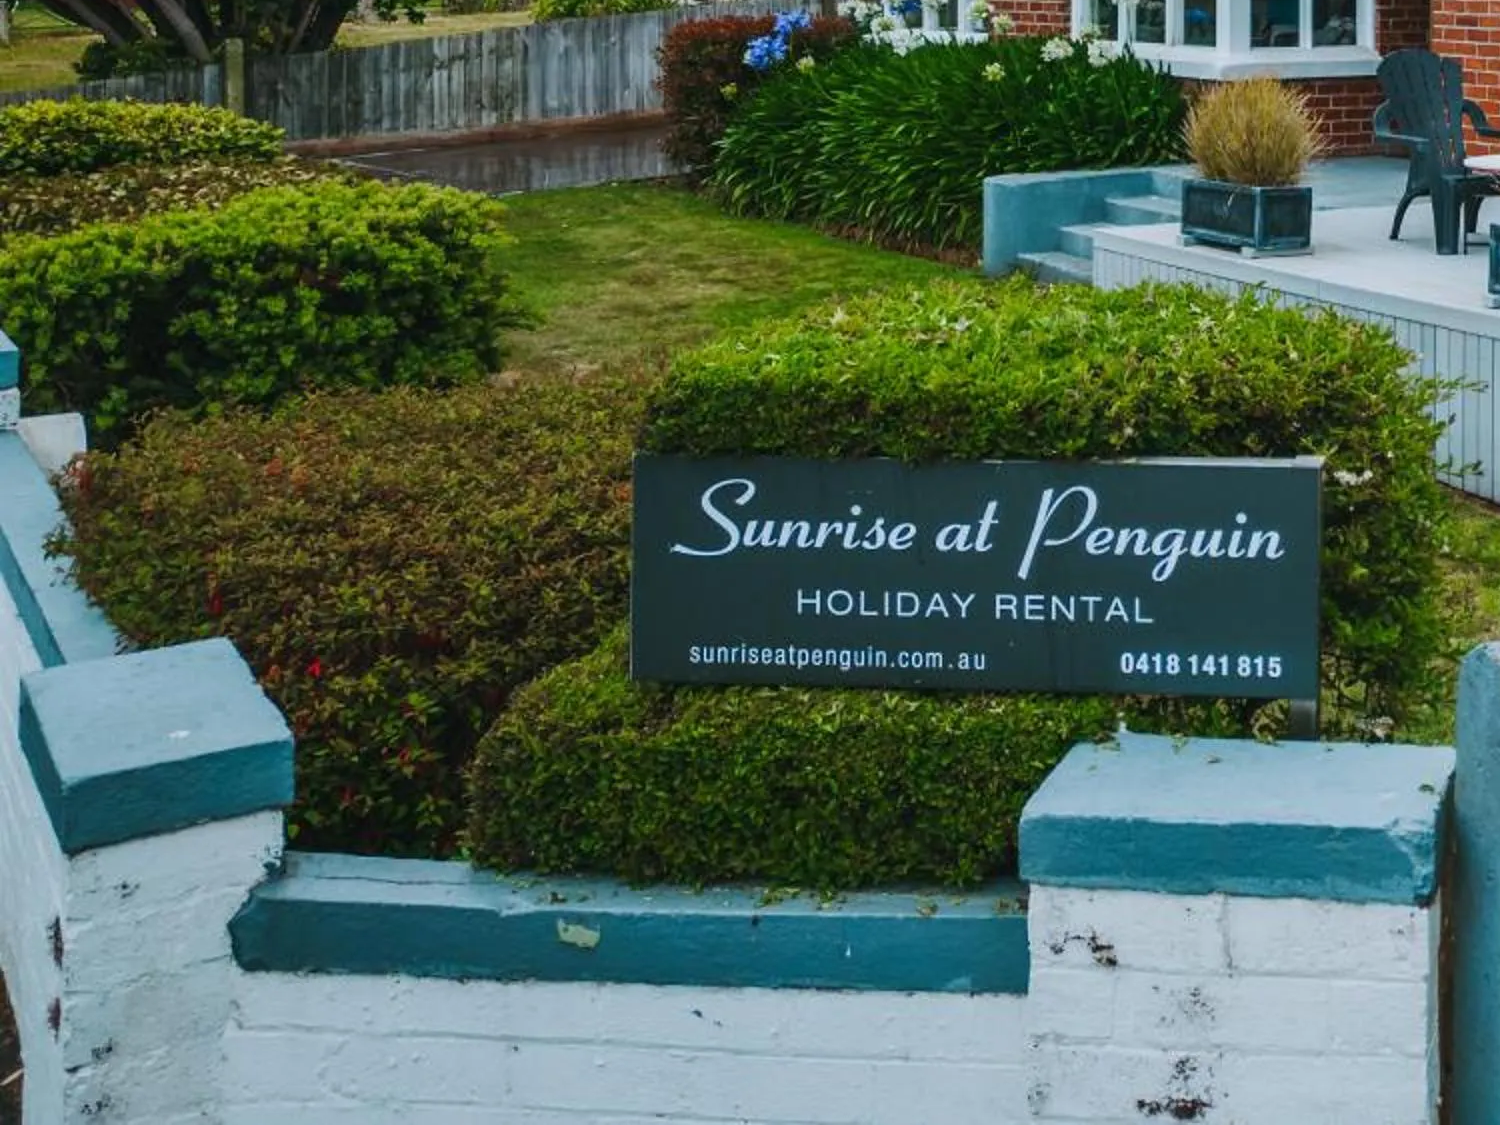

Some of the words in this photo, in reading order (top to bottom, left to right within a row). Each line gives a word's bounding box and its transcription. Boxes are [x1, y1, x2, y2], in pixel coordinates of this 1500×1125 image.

[669, 477, 918, 557] Sunrise
[935, 500, 1000, 553] at
[1016, 485, 1286, 583] Penguin
[796, 589, 976, 618] HOLIDAY
[994, 594, 1155, 624] RENTAL
[688, 643, 986, 671] sunriseatpenguin.com.au
[1120, 651, 1181, 676] 0418
[1186, 654, 1230, 677] 141
[1236, 655, 1283, 679] 815
